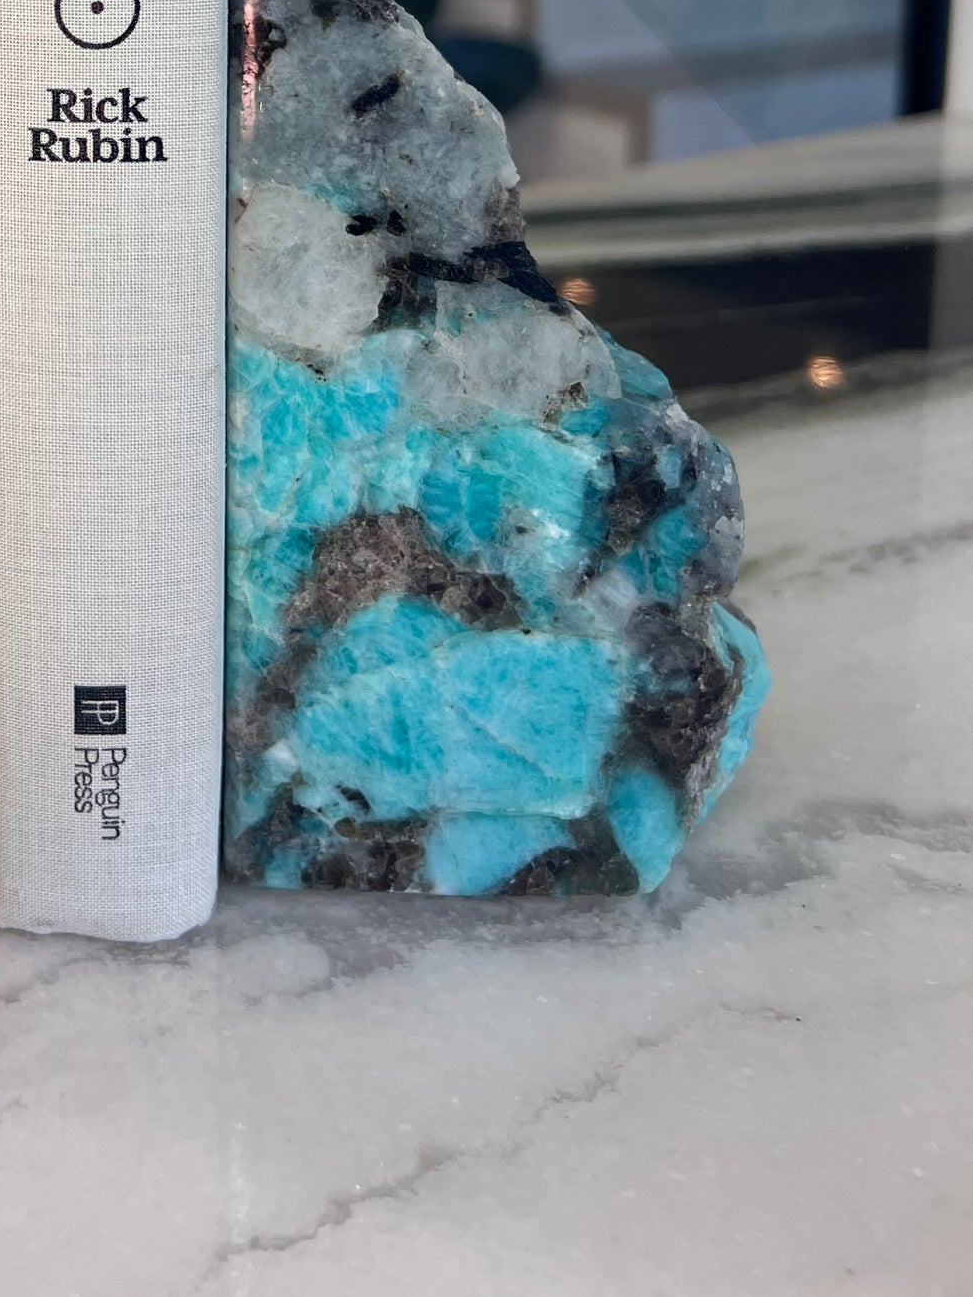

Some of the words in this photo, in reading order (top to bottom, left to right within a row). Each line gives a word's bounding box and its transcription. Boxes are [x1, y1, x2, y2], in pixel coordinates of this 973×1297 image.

[47, 87, 148, 124] Rick
[28, 127, 168, 163] Rubin
[74, 747, 100, 814] Press
[94, 746, 128, 841] Penguin
